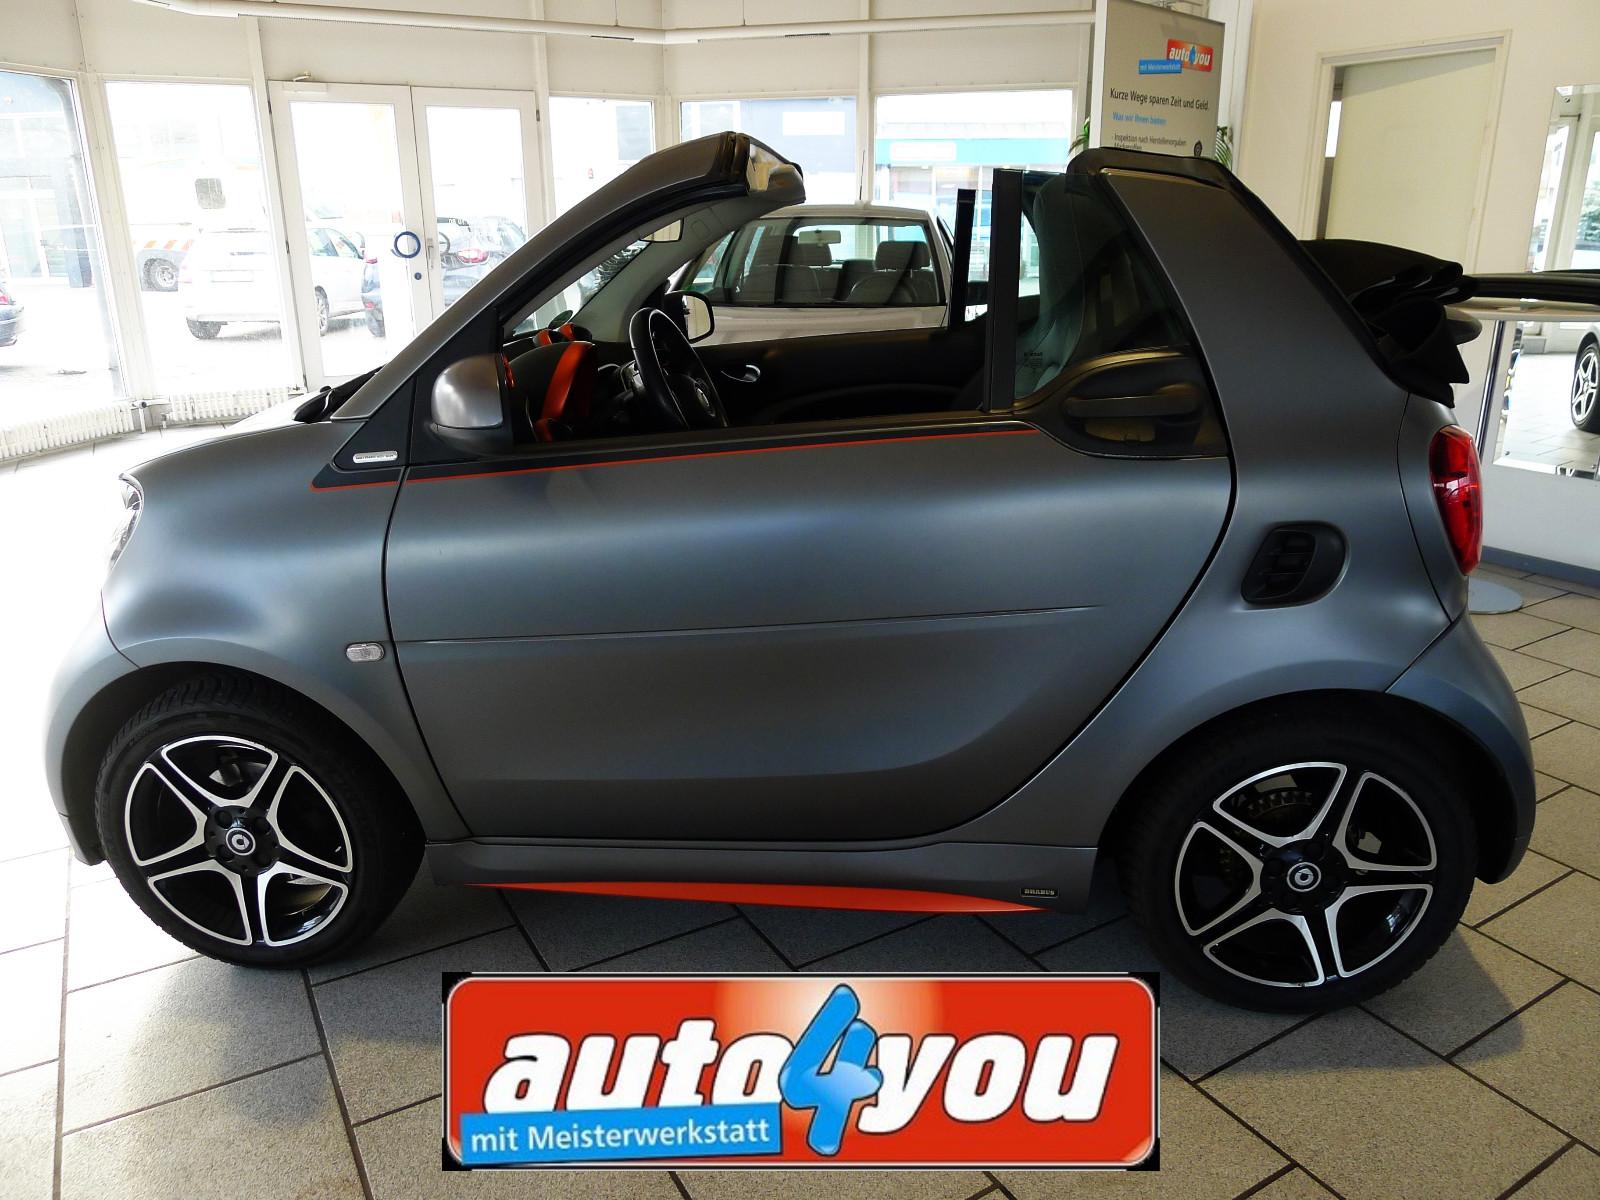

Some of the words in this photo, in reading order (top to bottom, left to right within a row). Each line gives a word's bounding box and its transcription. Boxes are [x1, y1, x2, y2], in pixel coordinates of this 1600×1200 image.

[1110, 88, 1129, 100] Kurze
[1130, 90, 1148, 105] Wege
[1149, 95, 1170, 107] sparen
[1171, 96, 1182, 108] Zeit
[1183, 99, 1194, 109] und
[1114, 133, 1138, 144] Inspektion
[1138, 135, 1148, 144] nach
